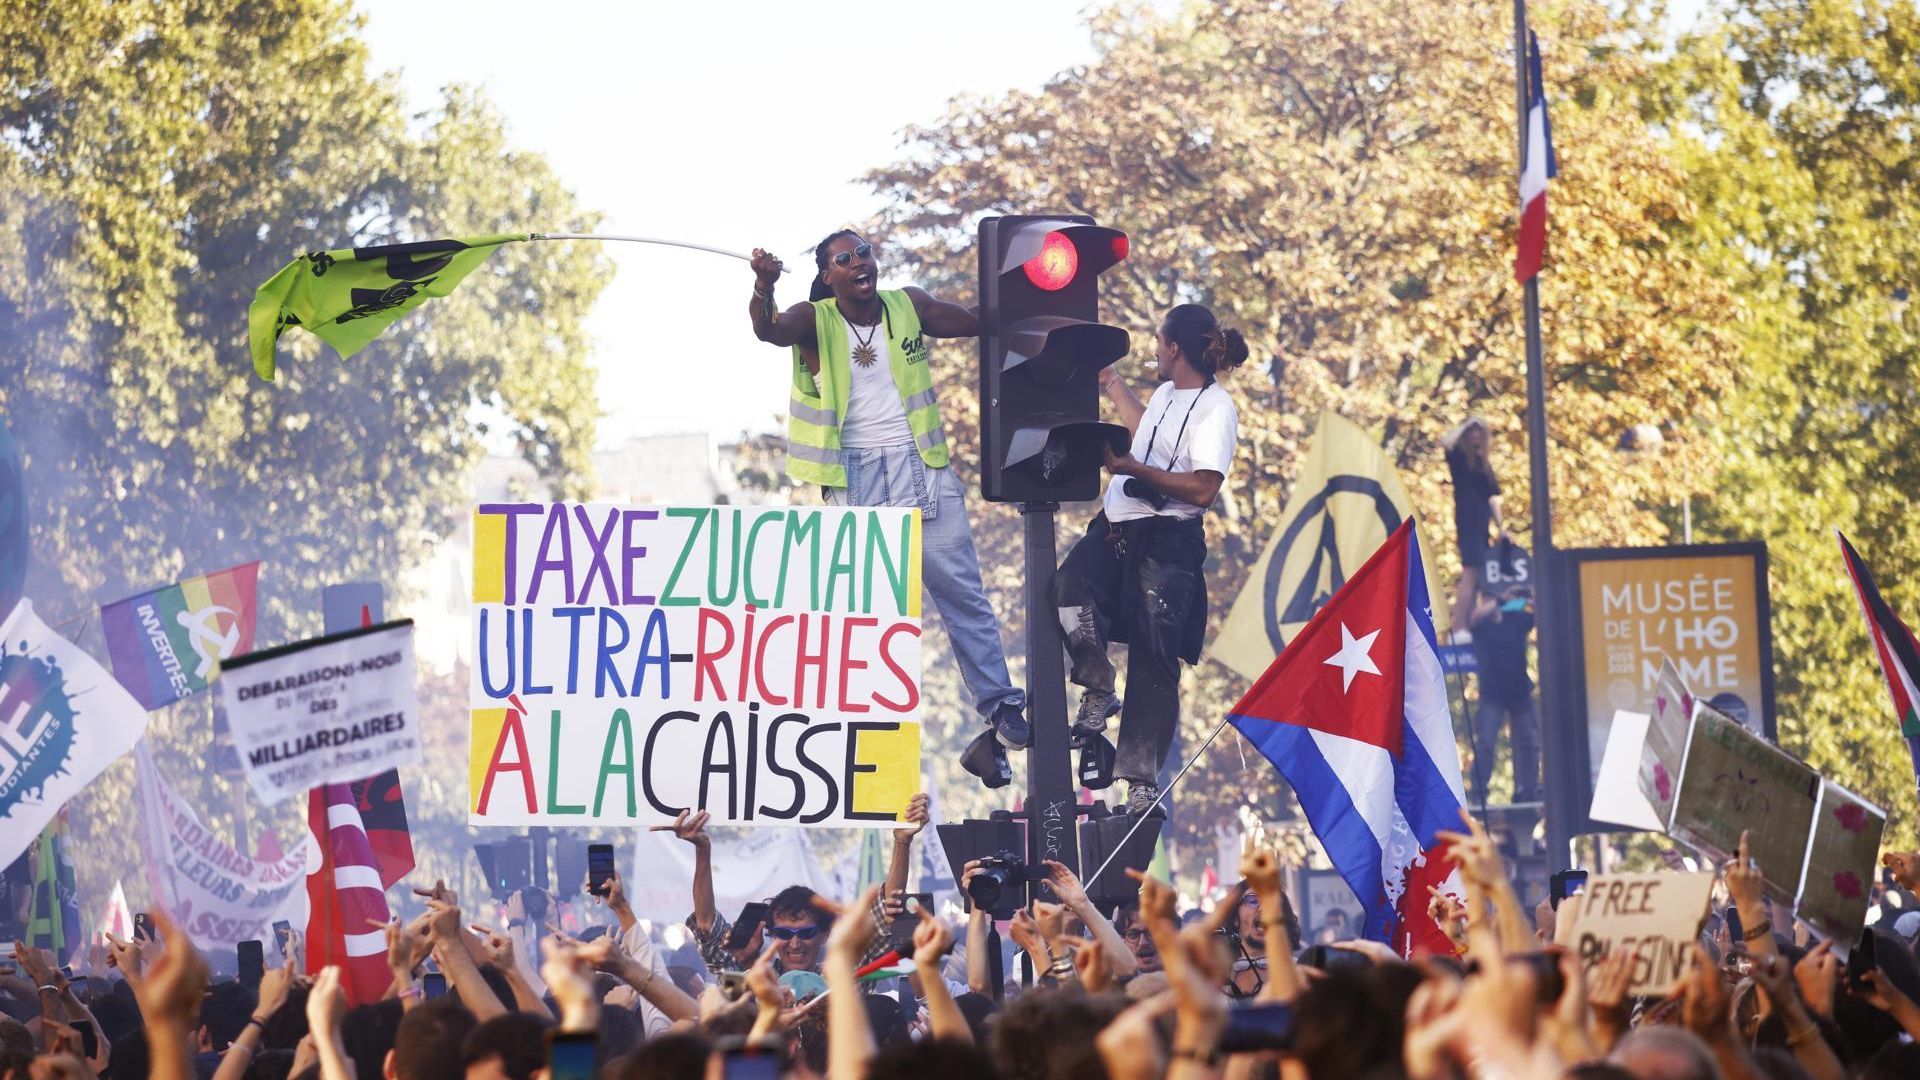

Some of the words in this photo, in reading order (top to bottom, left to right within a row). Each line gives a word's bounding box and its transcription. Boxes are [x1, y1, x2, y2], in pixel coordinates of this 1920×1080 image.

[479, 503, 659, 606] TAXE
[660, 507, 911, 616] ZUCMAN
[1602, 573, 1734, 615] MUSÉE
[1604, 619, 1632, 639] DE
[248, 711, 405, 767] MILLIARDAIRES
[476, 694, 538, 816] À
[546, 708, 637, 818] LA
[1584, 879, 1662, 917] FREE
